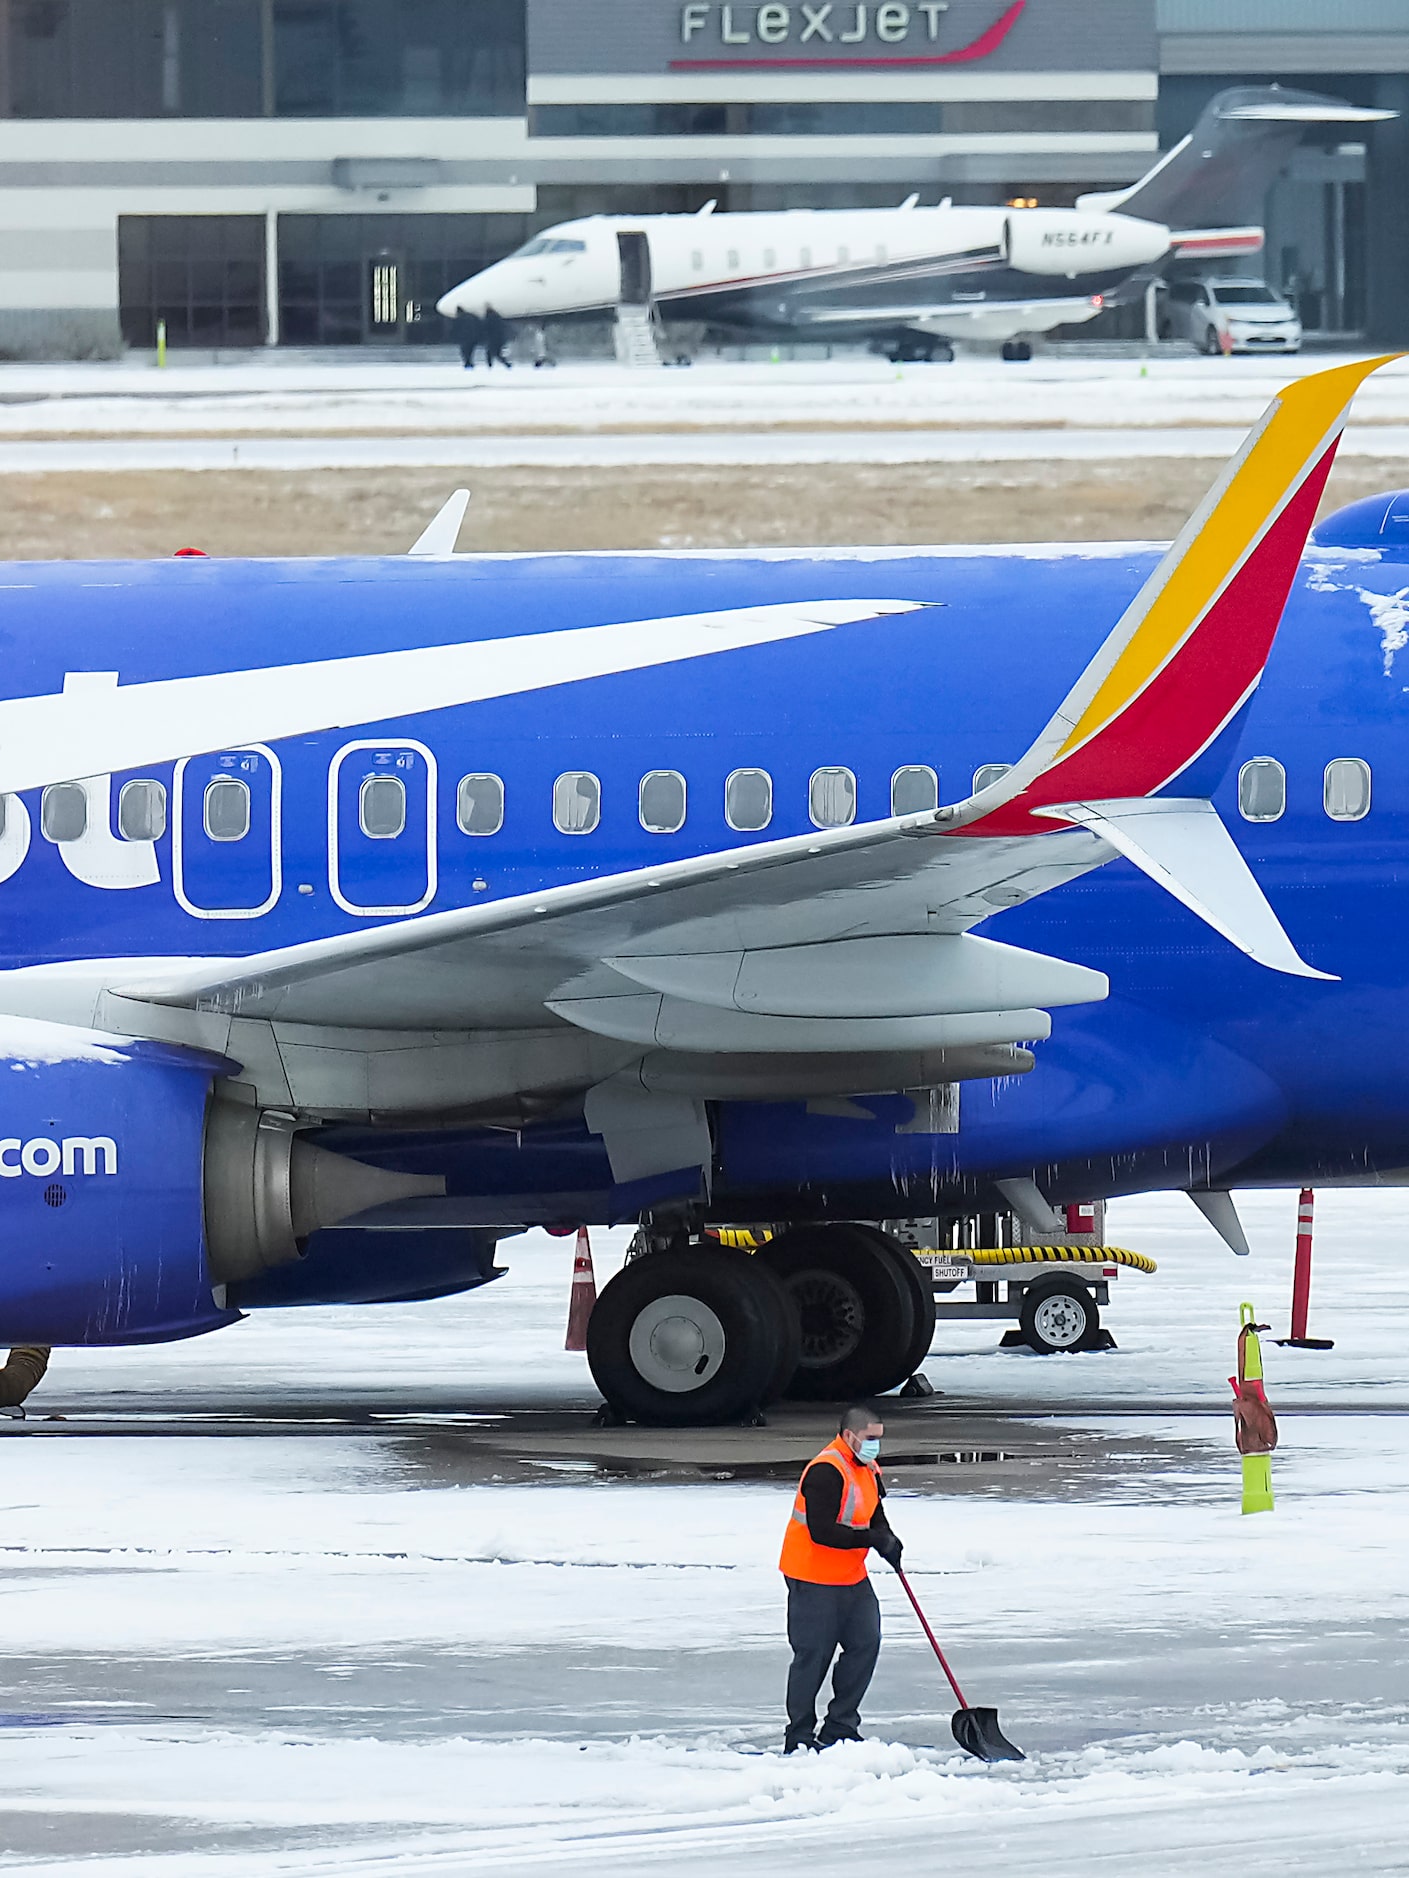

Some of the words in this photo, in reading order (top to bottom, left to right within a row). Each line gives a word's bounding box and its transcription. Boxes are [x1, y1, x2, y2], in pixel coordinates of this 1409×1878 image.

[918, 1256, 932, 1265] NCY
[934, 1256, 951, 1265] FUEL
[935, 1268, 965, 1277] SHUTOFF
